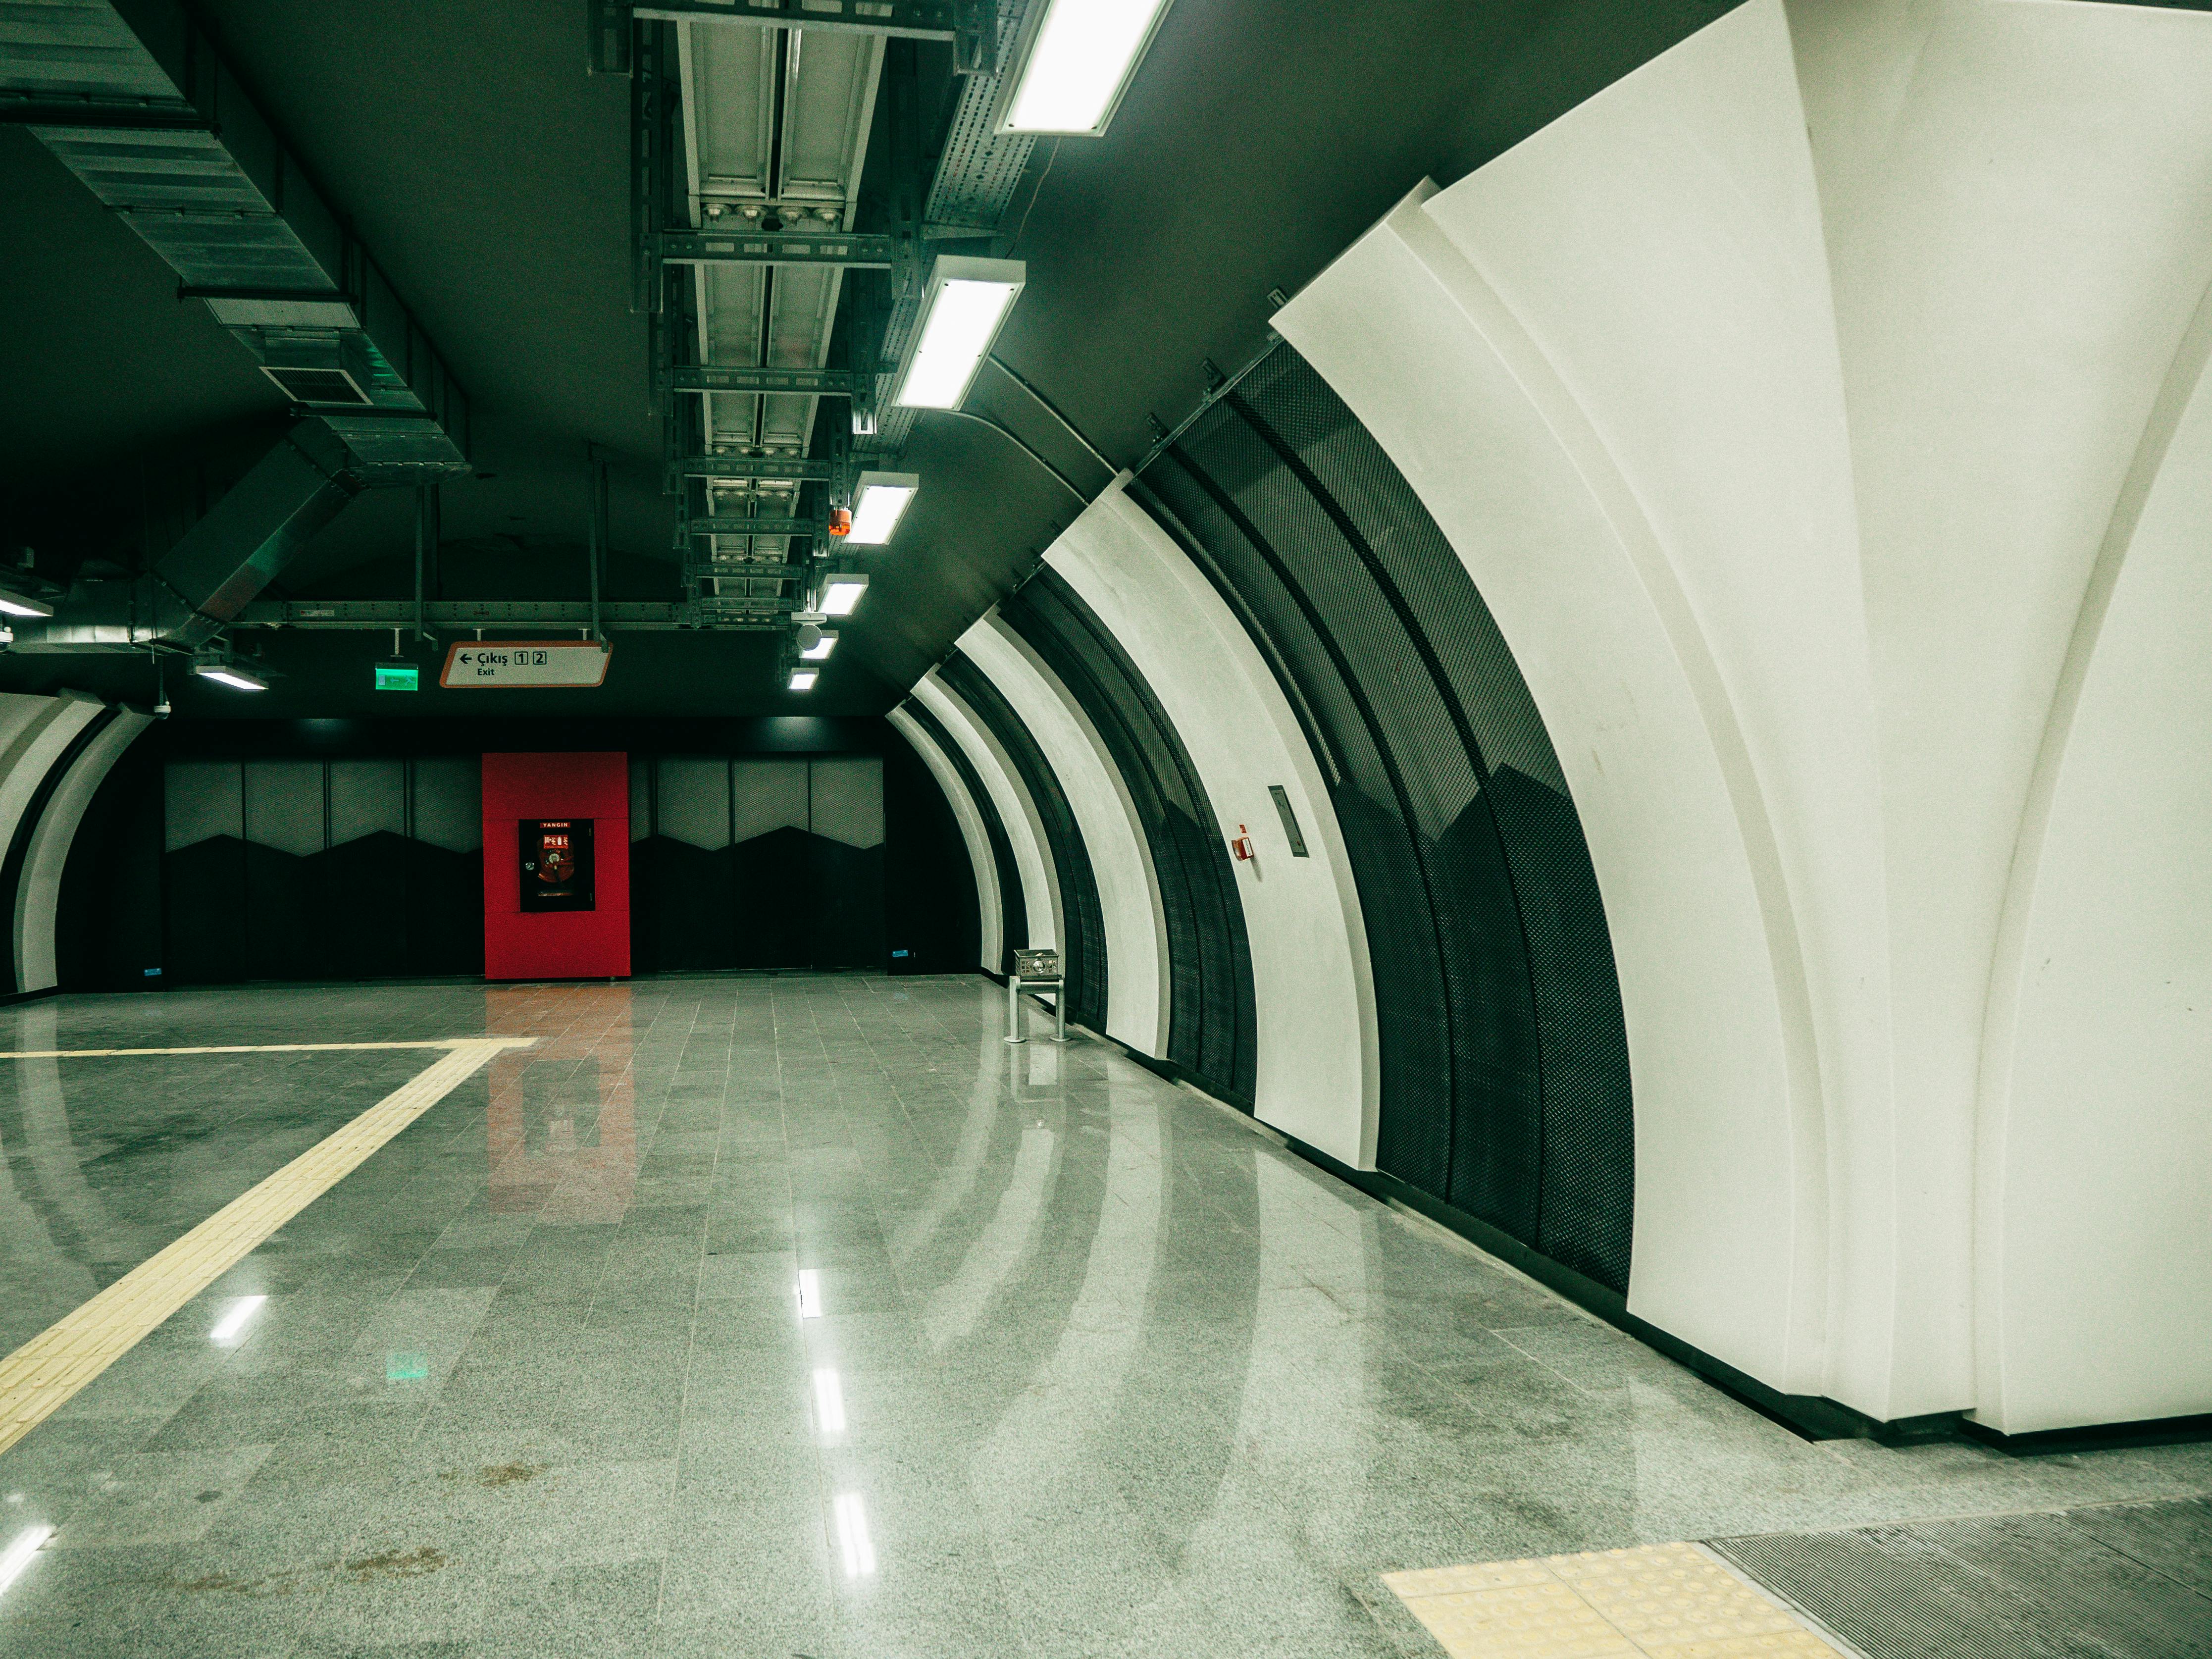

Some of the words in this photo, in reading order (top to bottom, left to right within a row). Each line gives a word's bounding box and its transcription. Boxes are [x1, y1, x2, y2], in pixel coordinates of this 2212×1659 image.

[477, 652, 508, 667] Çıkış
[518, 653, 523, 663] 1
[536, 653, 543, 663] 2
